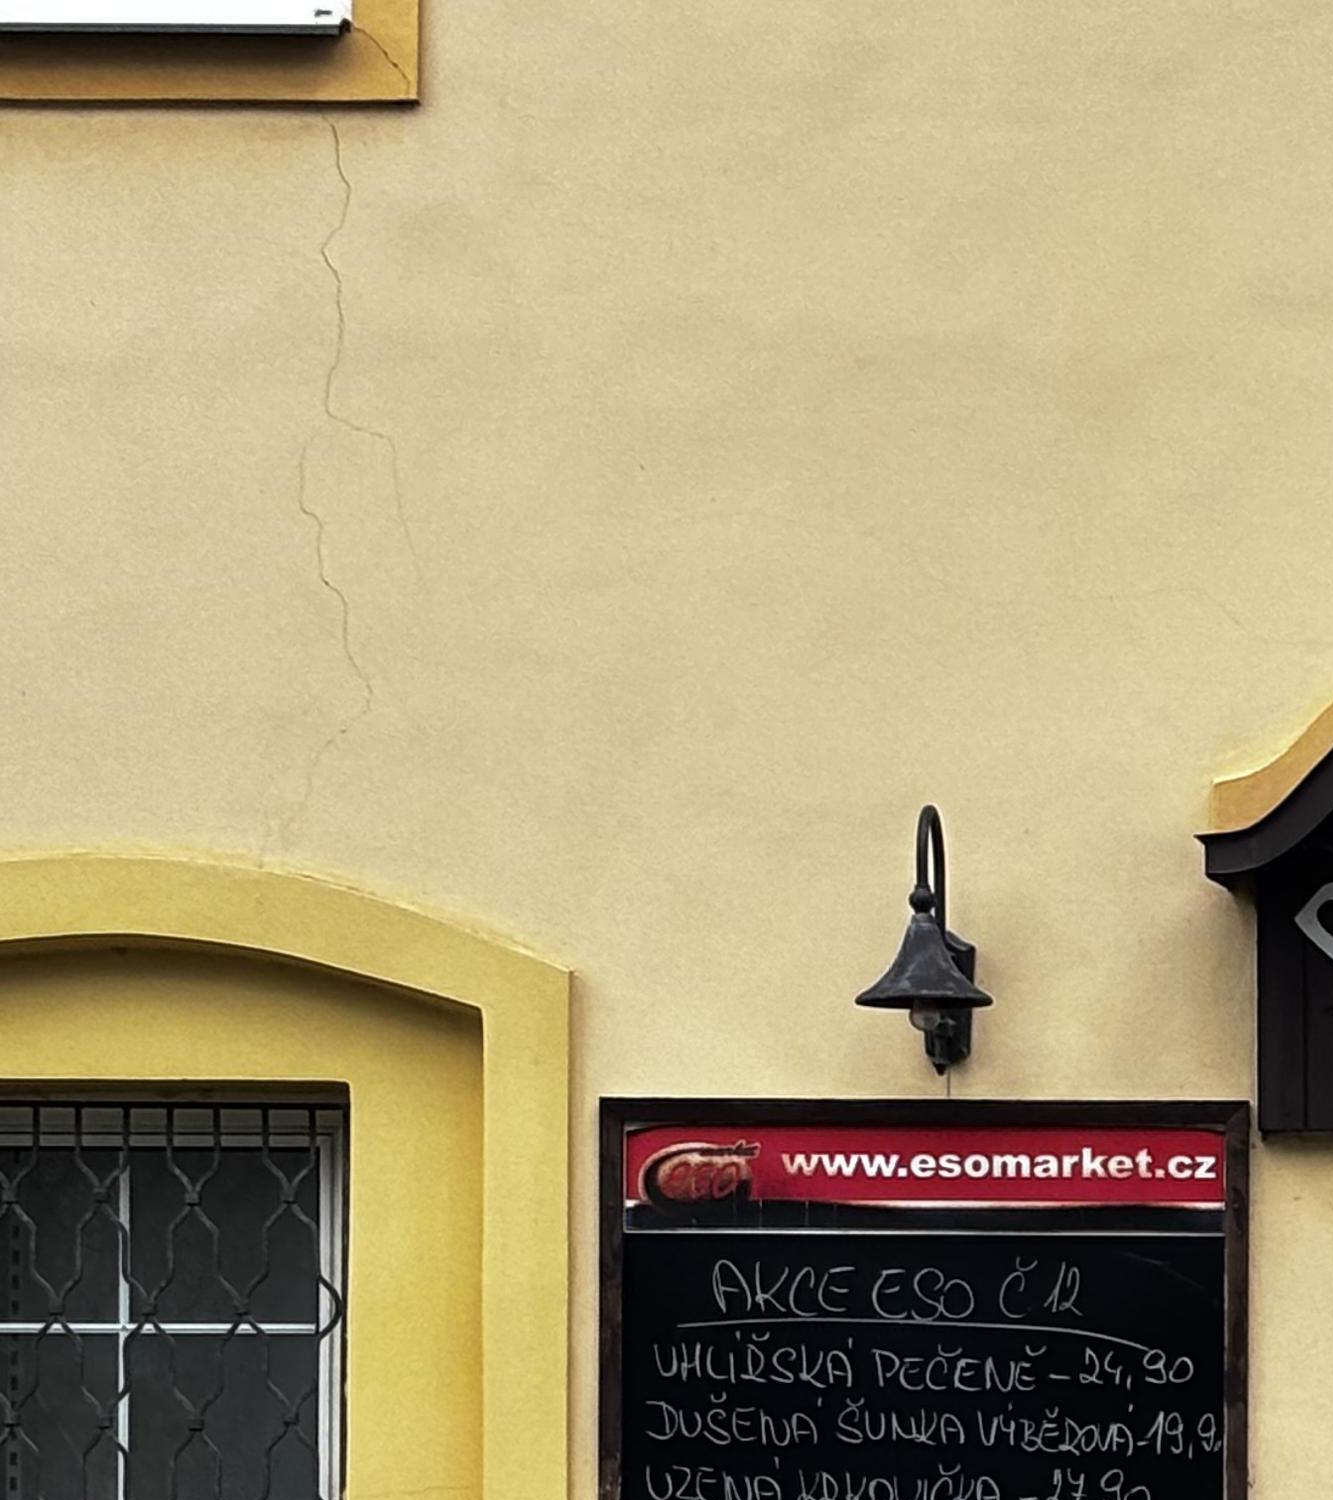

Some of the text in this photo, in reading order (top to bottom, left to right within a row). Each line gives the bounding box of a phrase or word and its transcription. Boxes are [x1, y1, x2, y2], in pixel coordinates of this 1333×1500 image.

[781, 1148, 1216, 1178] www.esomarket.cz
[712, 1259, 855, 1317] AKCE
[872, 1267, 974, 1322] ESO
[1044, 1261, 1083, 1316] 12
[653, 1330, 853, 1389] UHLÍŘSKÁ
[871, 1344, 1047, 1392] PEČENĚ
[645, 1392, 822, 1447] DUŠENÁ
[836, 1397, 965, 1446] ŠUNKA
